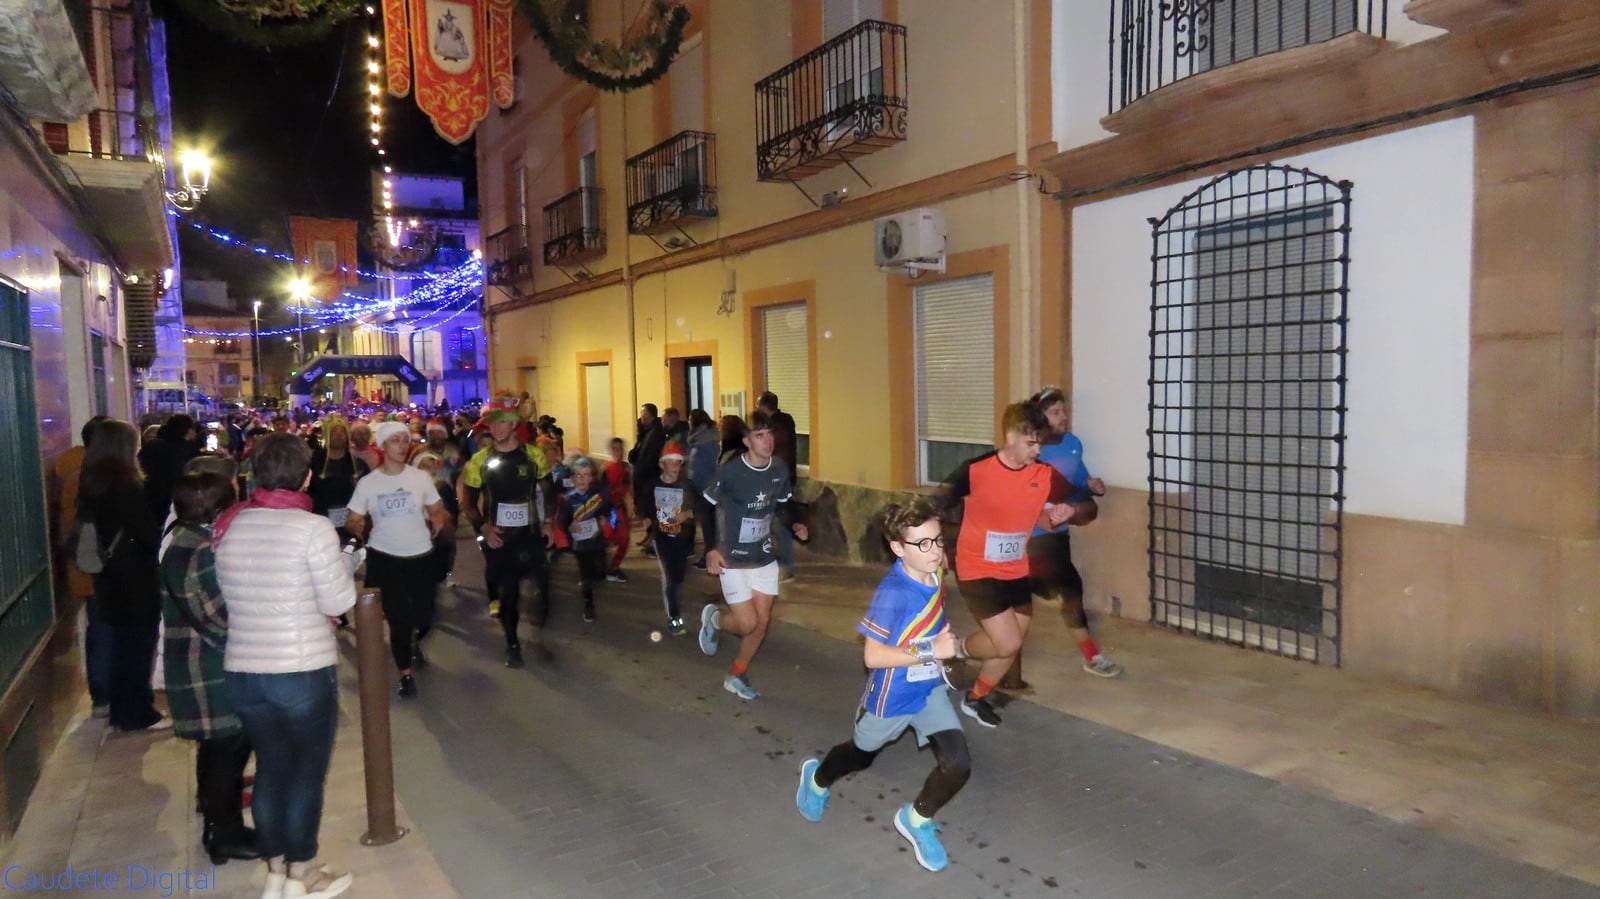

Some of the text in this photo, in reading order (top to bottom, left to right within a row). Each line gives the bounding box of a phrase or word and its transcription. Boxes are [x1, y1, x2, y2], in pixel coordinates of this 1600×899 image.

[385, 497, 407, 510] 007
[505, 510, 524, 520] 005
[997, 541, 1020, 554] 120
